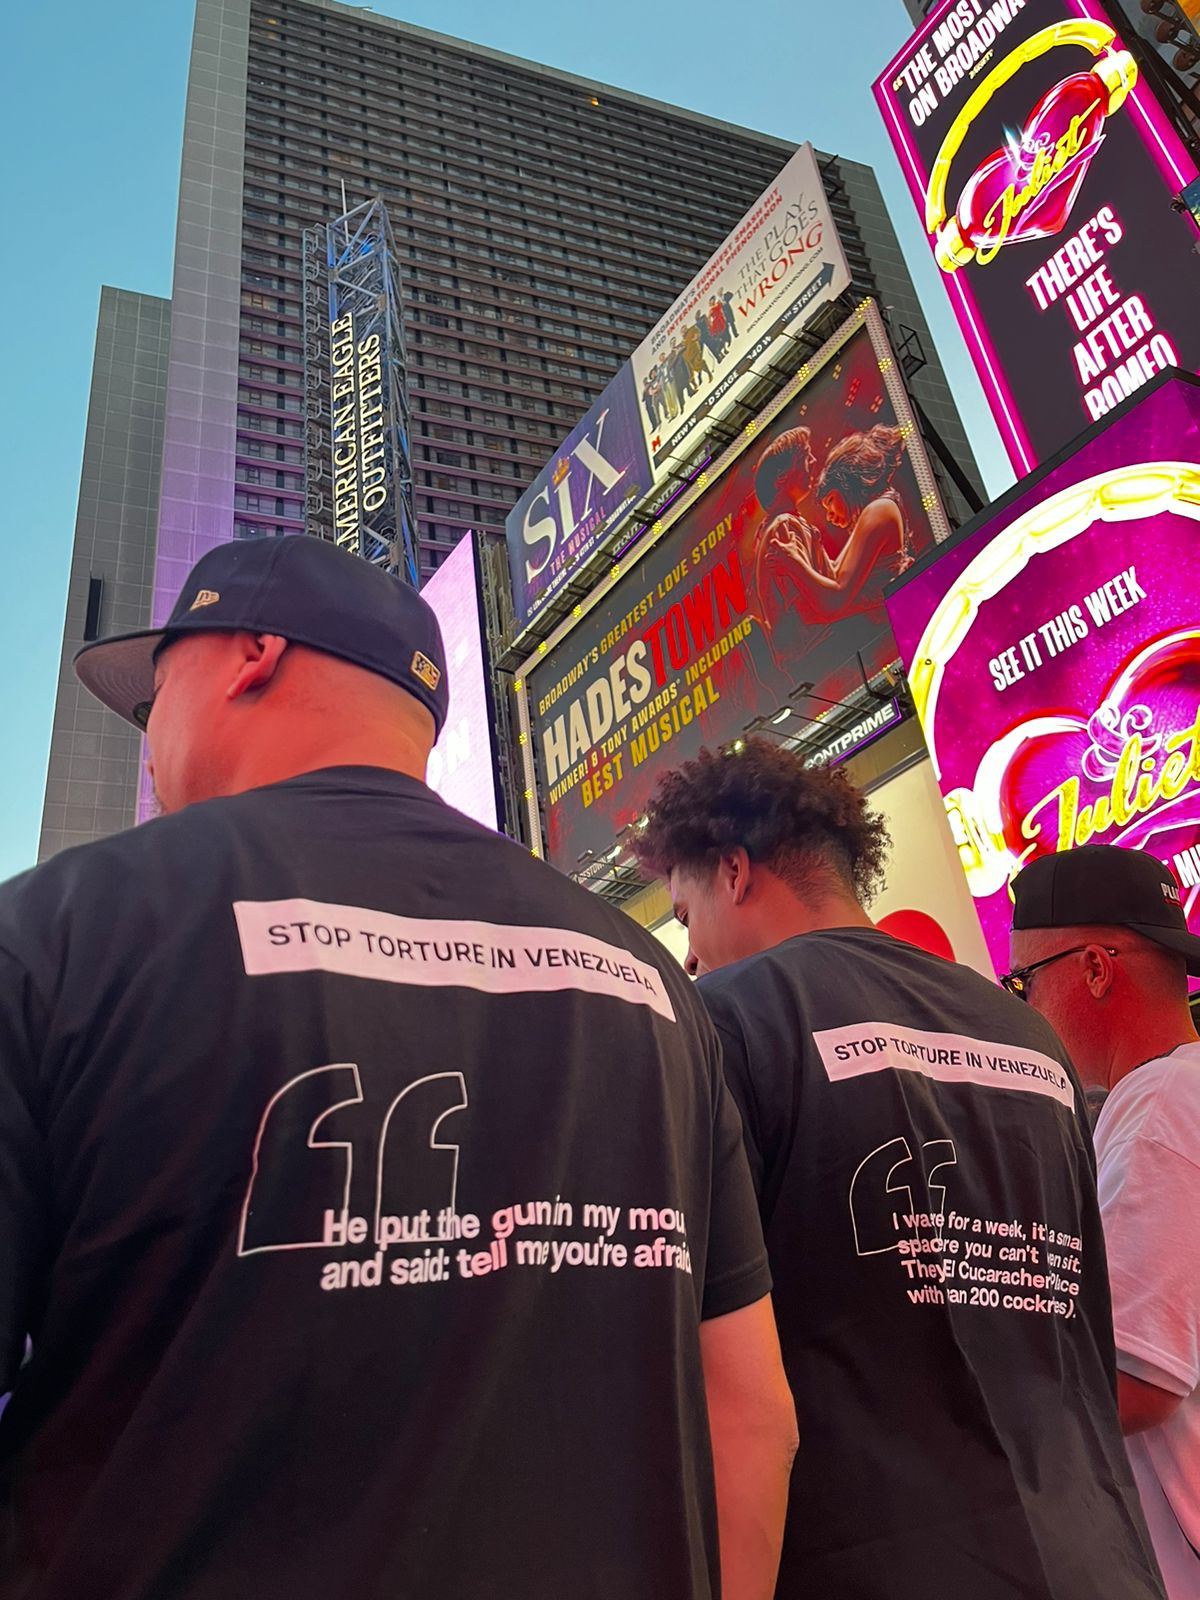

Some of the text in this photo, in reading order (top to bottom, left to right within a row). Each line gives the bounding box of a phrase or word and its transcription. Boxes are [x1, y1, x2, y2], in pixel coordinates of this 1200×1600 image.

[909, 82, 939, 126] ON
[976, 98, 1101, 266] Juliet
[651, 336, 667, 355] AND
[666, 266, 725, 336] INTERNATIONAL
[725, 194, 783, 266] PHENOMENON
[696, 243, 734, 290] FUNNIEST
[734, 206, 763, 243] SMASH
[764, 187, 780, 210] HIT
[735, 200, 818, 300] THAT GOES
[738, 192, 804, 279] THE PLAY
[738, 222, 823, 317] WRONG
[1026, 205, 1124, 311] THERE'S
[1065, 263, 1121, 333] LIFE
[1072, 295, 1154, 386] AFTER
[332, 312, 355, 402] EAGLE
[671, 424, 689, 447] NEW
[714, 371, 739, 398] STAGE
[792, 277, 823, 314] STREET
[1083, 334, 1178, 422] ROMEO
[357, 333, 388, 512] OUTFITTERS
[523, 408, 627, 584] SIX
[550, 550, 566, 575] THE
[567, 505, 607, 556] MUSICAL
[539, 512, 734, 716] BROADWAY'S GREATEST LOVE STORY
[988, 565, 1148, 692] SEE IT THIS WEEK
[549, 762, 589, 806] WINNER!
[601, 727, 628, 758] TONY
[685, 616, 753, 687] INCLUDING
[581, 674, 721, 808] BEST MUSICAL
[268, 921, 658, 996] STOP TORTURE IN VENEZUELA
[834, 1036, 1067, 1091] STOP TORTURE IN VENEZUELA
[320, 1250, 384, 1290] and
[389, 1247, 450, 1285] said:
[456, 1238, 508, 1279] tell
[550, 1234, 628, 1273] you're
[323, 1208, 368, 1244] He
[380, 1209, 431, 1251] put
[438, 1206, 481, 1240] the
[583, 1203, 621, 1237] my
[629, 1206, 686, 1235] mou
[892, 1211, 900, 1231] I
[948, 1210, 971, 1231] for
[971, 1218, 983, 1233] a
[1048, 1229, 1056, 1243] a
[965, 1241, 993, 1260] you
[999, 1244, 1040, 1264] can't
[1061, 1254, 1082, 1274] sit.
[906, 1284, 945, 1305] with
[969, 1286, 1000, 1308] 200
